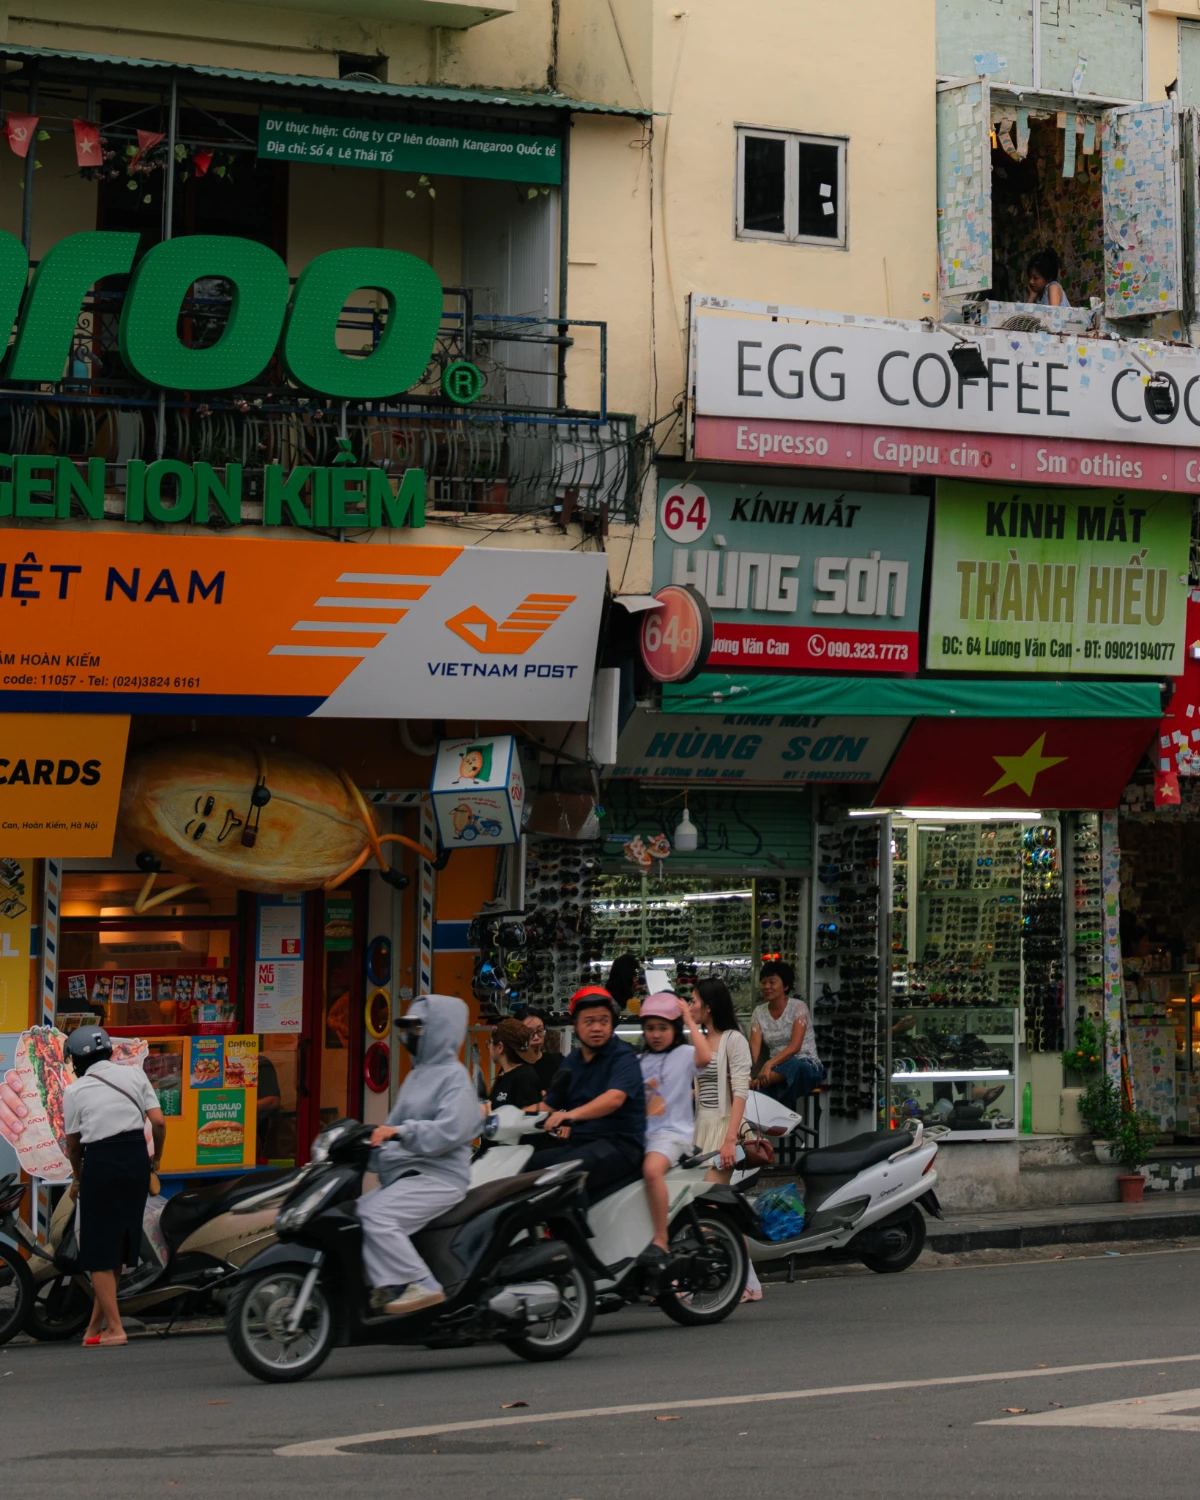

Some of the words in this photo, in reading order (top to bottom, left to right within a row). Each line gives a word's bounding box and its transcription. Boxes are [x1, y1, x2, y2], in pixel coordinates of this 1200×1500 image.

[265, 119, 283, 132] ĐV
[285, 121, 309, 135] thực
[315, 125, 339, 138] hiện:
[342, 127, 369, 143] Công
[372, 131, 383, 144] ty
[386, 131, 401, 143] CP
[403, 133, 423, 146] liên
[425, 135, 459, 149] doanh
[462, 139, 514, 154] Kangaroo
[515, 142, 543, 157] Quốc
[545, 143, 556, 157] tế
[266, 141, 286, 153] Địa
[287, 143, 307, 155] chỉ:
[309, 144, 325, 157] Số
[325, 147, 333, 157] 4
[338, 147, 352, 159] Lê
[353, 149, 377, 162] Thái
[380, 148, 394, 163] Tổ
[737, 340, 846, 401] EGG
[877, 350, 1070, 417] COFFEE
[736, 425, 829, 458] Espresso
[126, 459, 242, 525] ION
[264, 437, 426, 529] KIỀM
[664, 494, 707, 531] 64
[729, 491, 800, 524] KÍNH
[800, 492, 862, 528] MẮT
[985, 494, 1066, 540] KÍNH
[1076, 493, 1147, 543] MẮT
[105, 566, 226, 605] NAM
[955, 548, 1077, 624] THÀNH
[20, 651, 61, 666] HOÀN
[65, 651, 101, 667] KIẾM
[742, 637, 764, 655] Văn
[766, 638, 790, 657] Can
[827, 641, 909, 661] 090.323.7773
[941, 636, 963, 655] ĐC:
[966, 636, 982, 656] 64
[984, 636, 1021, 659] Lương
[1024, 637, 1048, 658] Văn
[1050, 639, 1073, 658] Can
[1084, 640, 1102, 659] ĐT:
[1105, 641, 1175, 661] 0902194077
[3, 674, 37, 685] code:
[40, 674, 76, 686] 11057
[88, 675, 109, 687] Tel:
[173, 676, 201, 688] 6161
[427, 661, 518, 678] VIETNAM
[523, 663, 579, 679] POST
[644, 726, 763, 761] HÙNG
[780, 734, 870, 763] SƠN
[2, 821, 20, 831] Can,
[22, 820, 44, 830] Hoàn
[45, 820, 69, 831] Kiếm,
[70, 821, 83, 830] Hà
[84, 821, 98, 831] Nội
[258, 973, 275, 985] NU
[259, 963, 274, 974] ME
[228, 1040, 257, 1048] Coffee
[202, 1103, 218, 1111] EGG
[218, 1102, 242, 1111] SALAD
[206, 1109, 228, 1120] BÁNH
